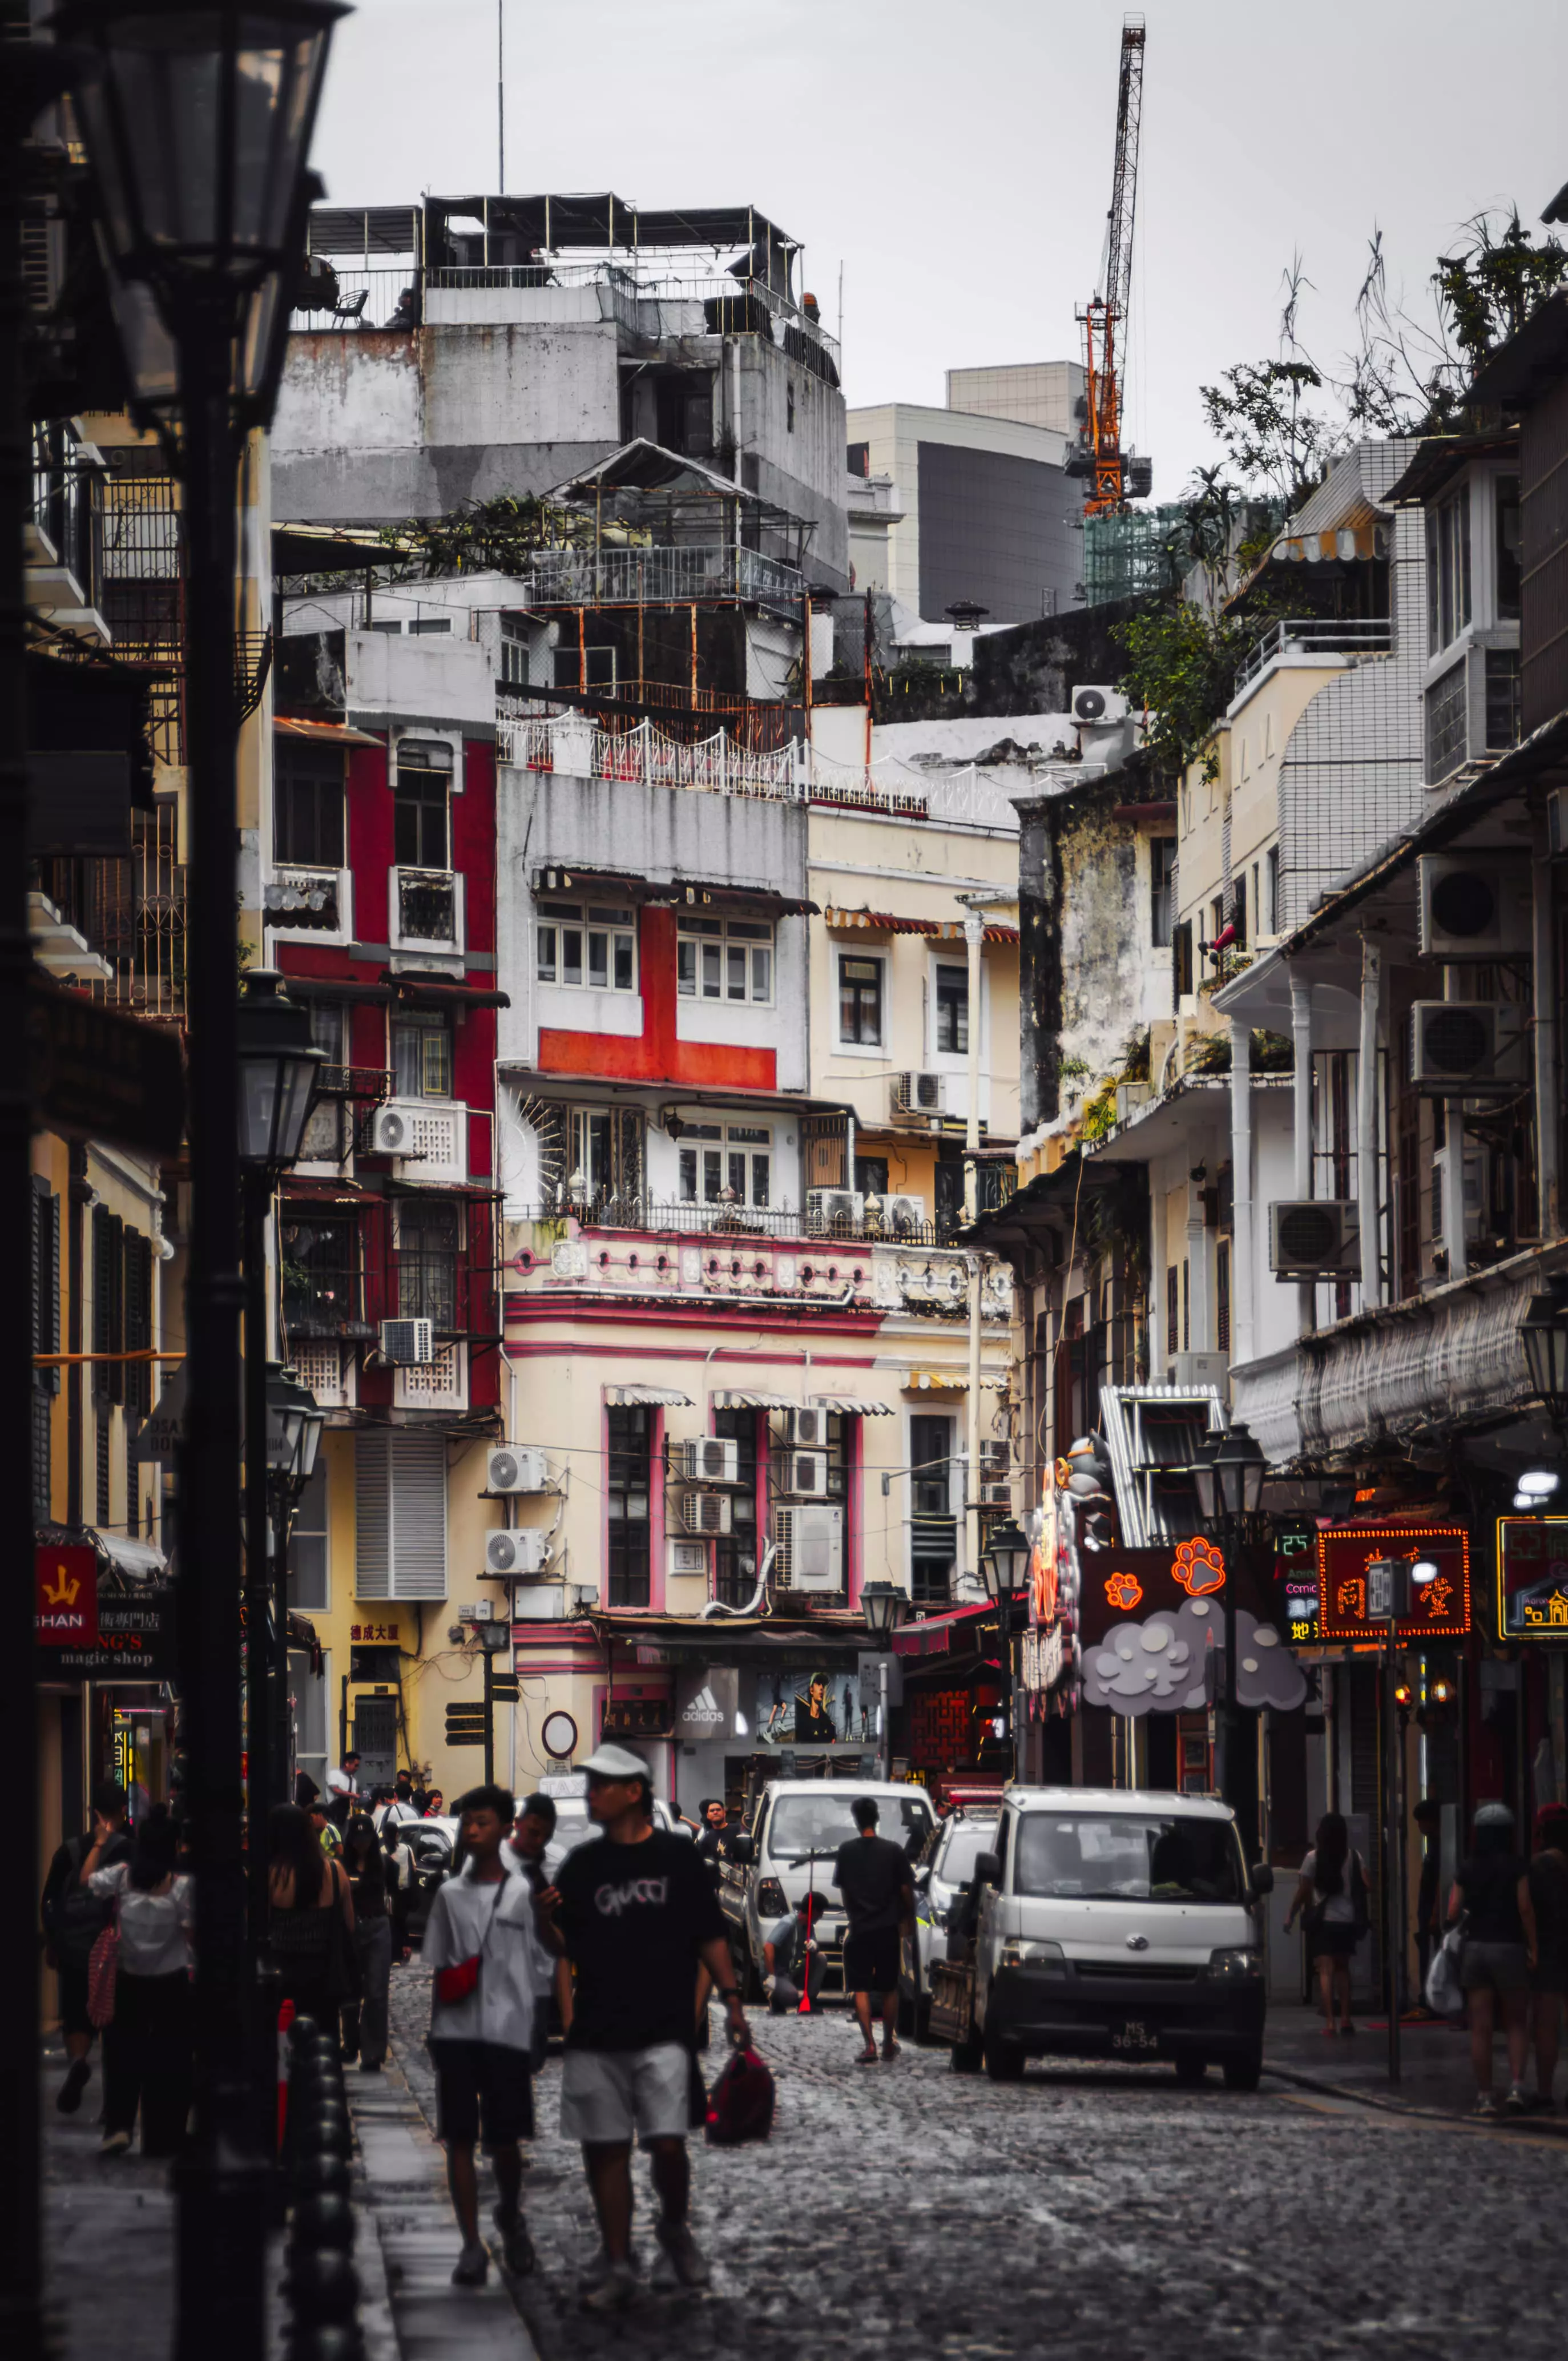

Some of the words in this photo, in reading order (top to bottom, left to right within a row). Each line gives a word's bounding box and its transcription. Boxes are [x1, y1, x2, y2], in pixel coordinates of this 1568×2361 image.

[1286, 1583, 1317, 1594] Comic
[73, 1632, 142, 1650] NG'S
[61, 1651, 108, 1667] magic
[114, 1651, 153, 1667] shop
[682, 1710, 724, 1722] adidas
